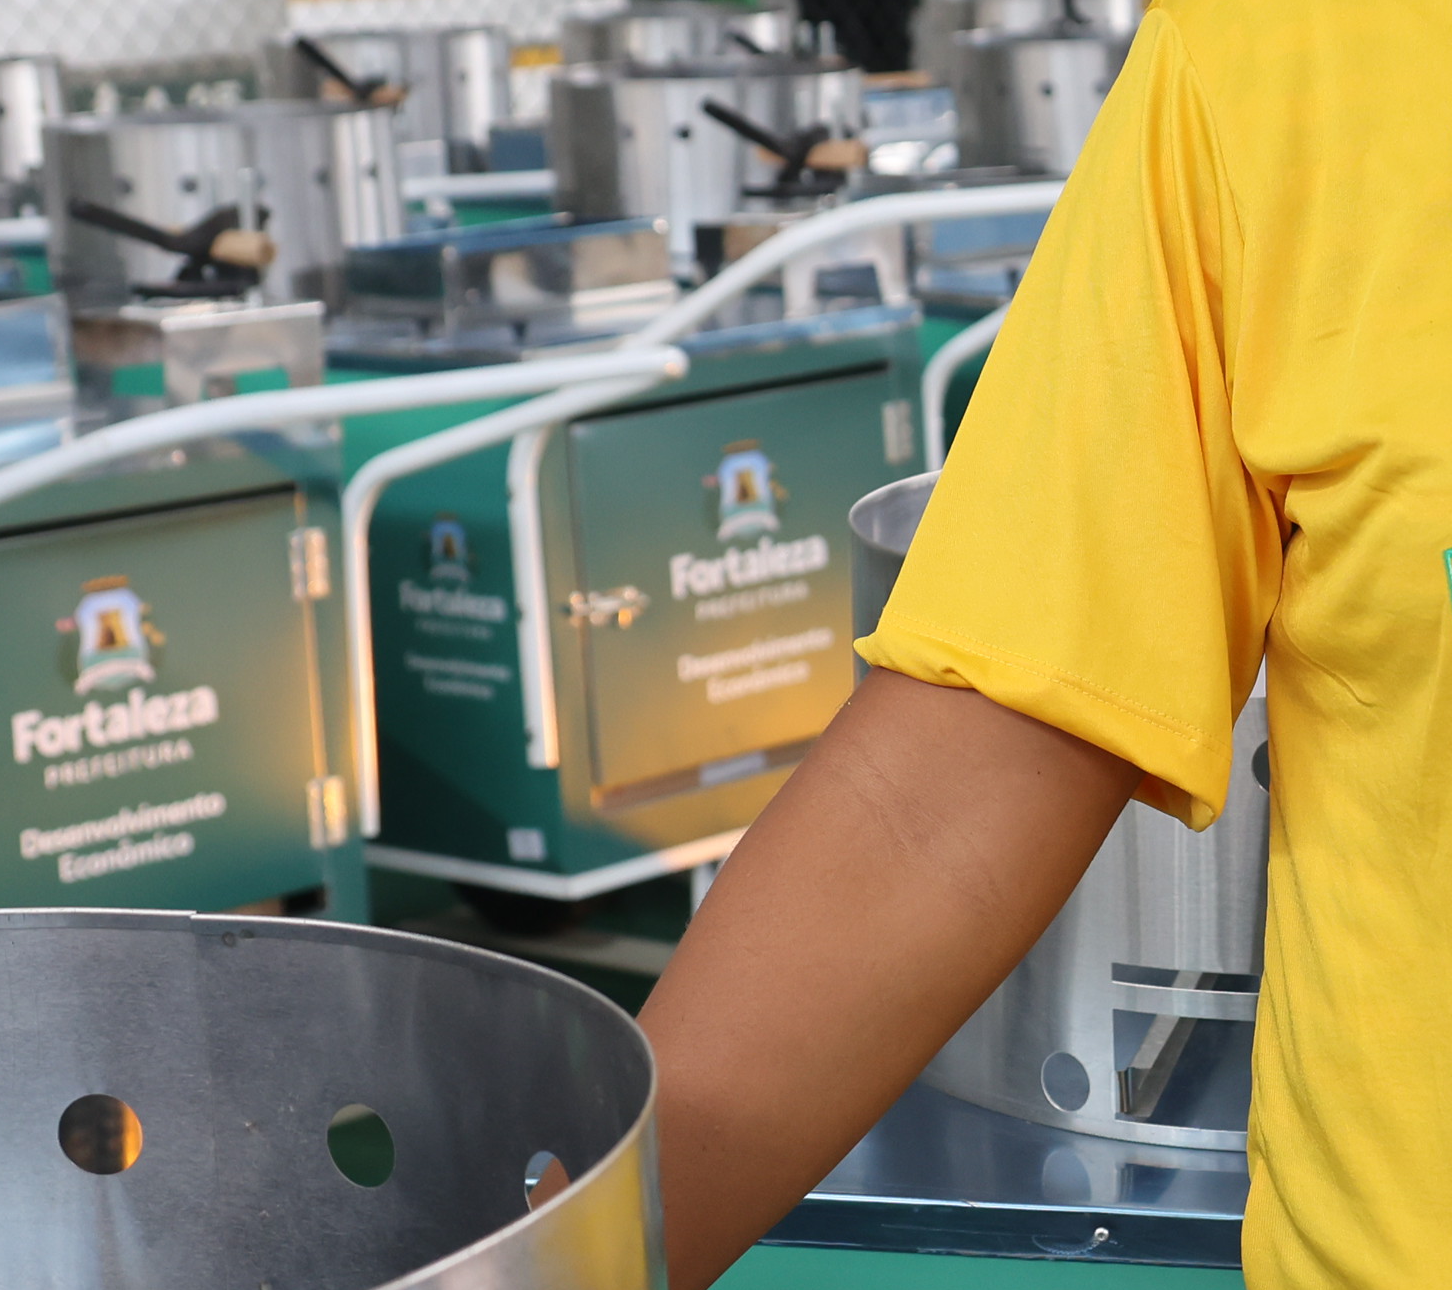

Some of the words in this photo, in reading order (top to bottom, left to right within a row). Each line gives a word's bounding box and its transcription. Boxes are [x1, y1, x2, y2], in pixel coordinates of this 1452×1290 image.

[669, 534, 829, 600] Fortaleza
[11, 685, 219, 764] Fortaleza
[44, 738, 194, 790] PREFEITURA
[19, 792, 227, 860] Desenvolvimento
[58, 831, 195, 884] Econômico
